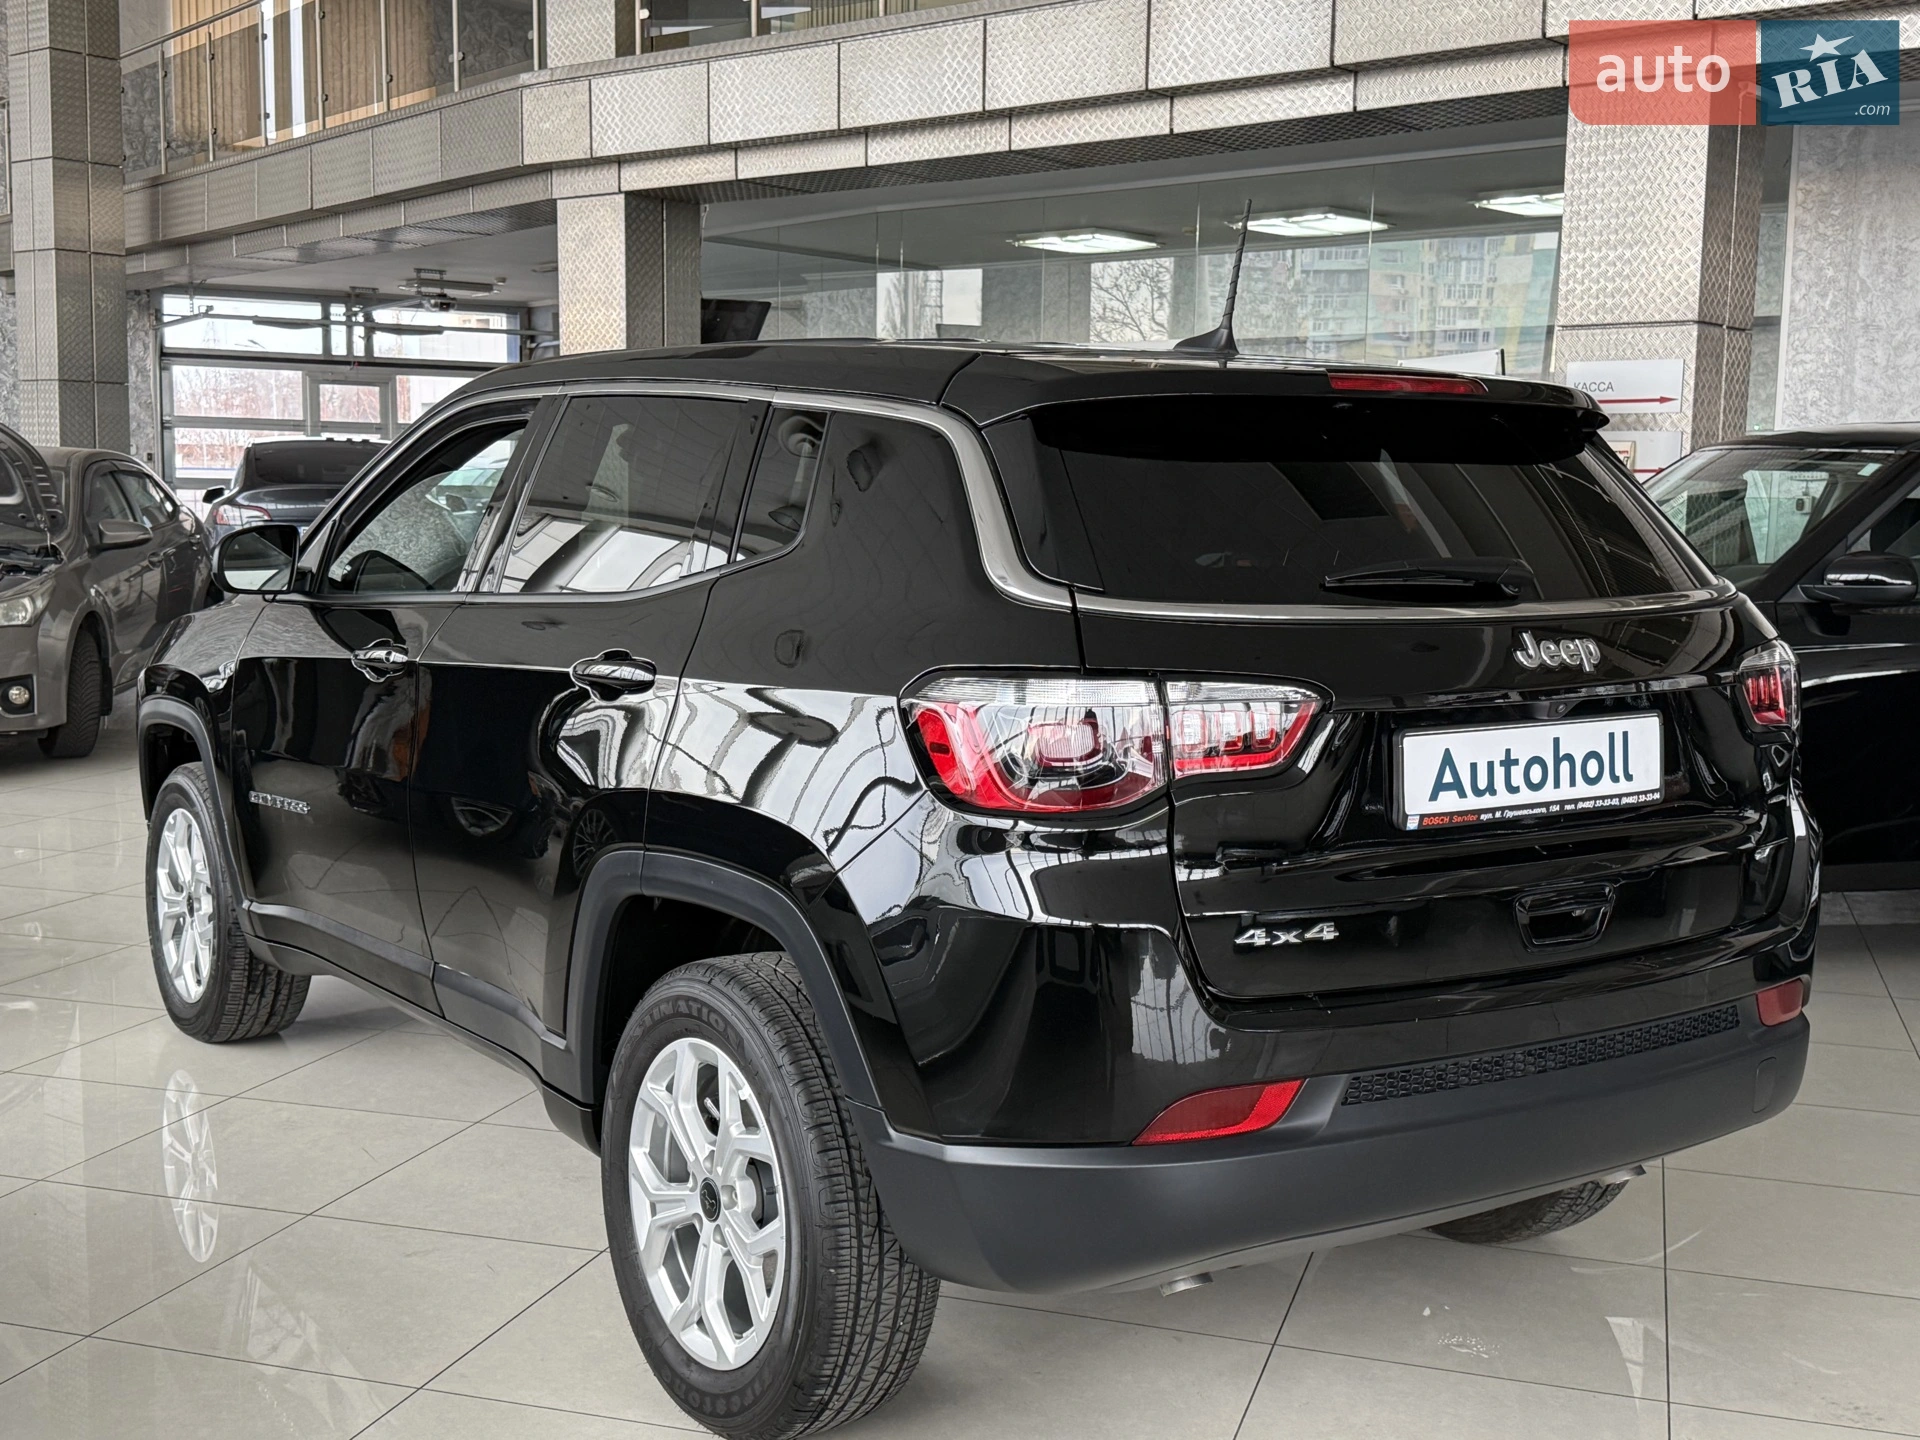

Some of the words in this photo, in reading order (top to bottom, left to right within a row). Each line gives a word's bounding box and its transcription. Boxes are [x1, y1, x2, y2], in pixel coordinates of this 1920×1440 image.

[1512, 629, 1601, 674] Jeep
[1428, 730, 1634, 802] Autoholl
[1422, 815, 1450, 826] BOSCH
[1452, 813, 1478, 823] Service
[1234, 921, 1340, 948] 4x4
